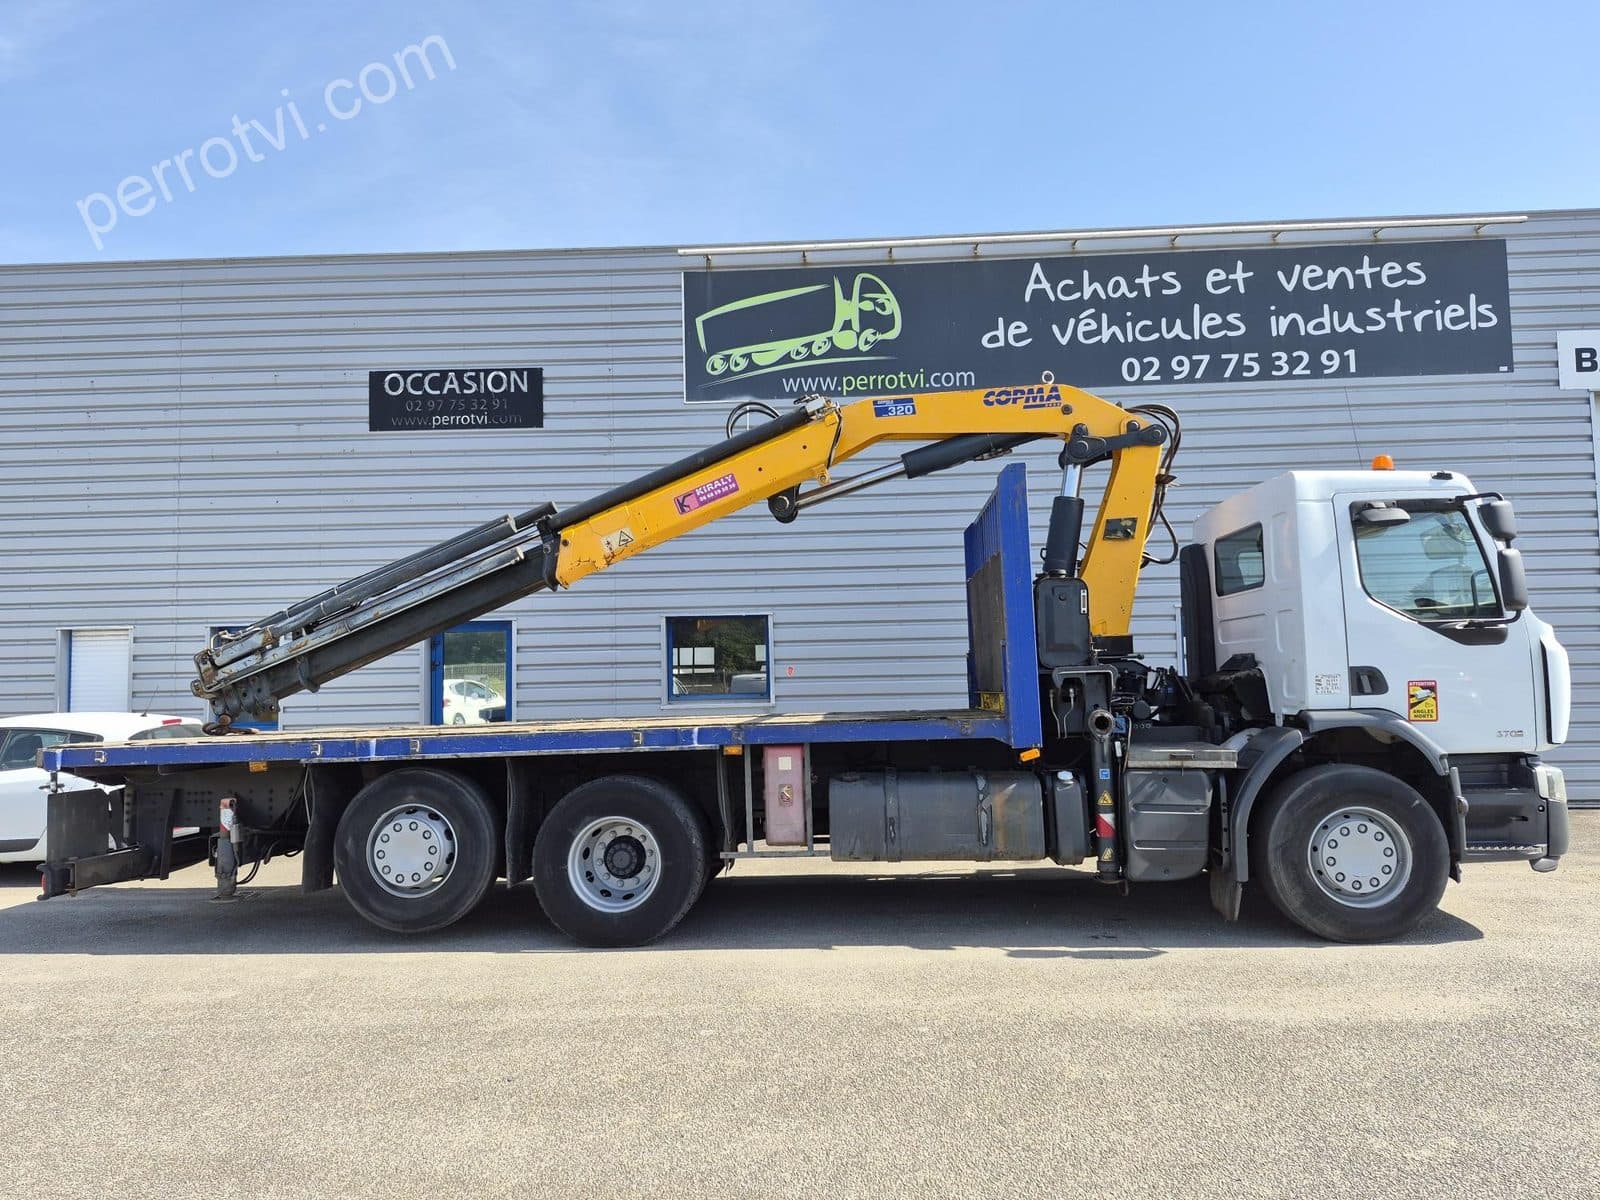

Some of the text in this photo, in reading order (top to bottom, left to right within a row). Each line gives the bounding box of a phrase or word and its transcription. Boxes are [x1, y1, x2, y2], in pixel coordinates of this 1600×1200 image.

[1024, 255, 1427, 302] Achats et ventes
[981, 293, 1498, 348] de véhicules industriels
[1121, 349, 1356, 382] 02 97 75 32 91
[1575, 347, 1600, 372] B
[384, 371, 528, 396] OCCASION
[782, 368, 975, 396] www.perrotvi.com
[406, 398, 508, 412] 02 97 75 32 91
[983, 386, 1062, 407] COPMA
[391, 412, 522, 428] www.perrotvi.com
[888, 405, 913, 416] 320
[695, 474, 733, 496] KIRALY
